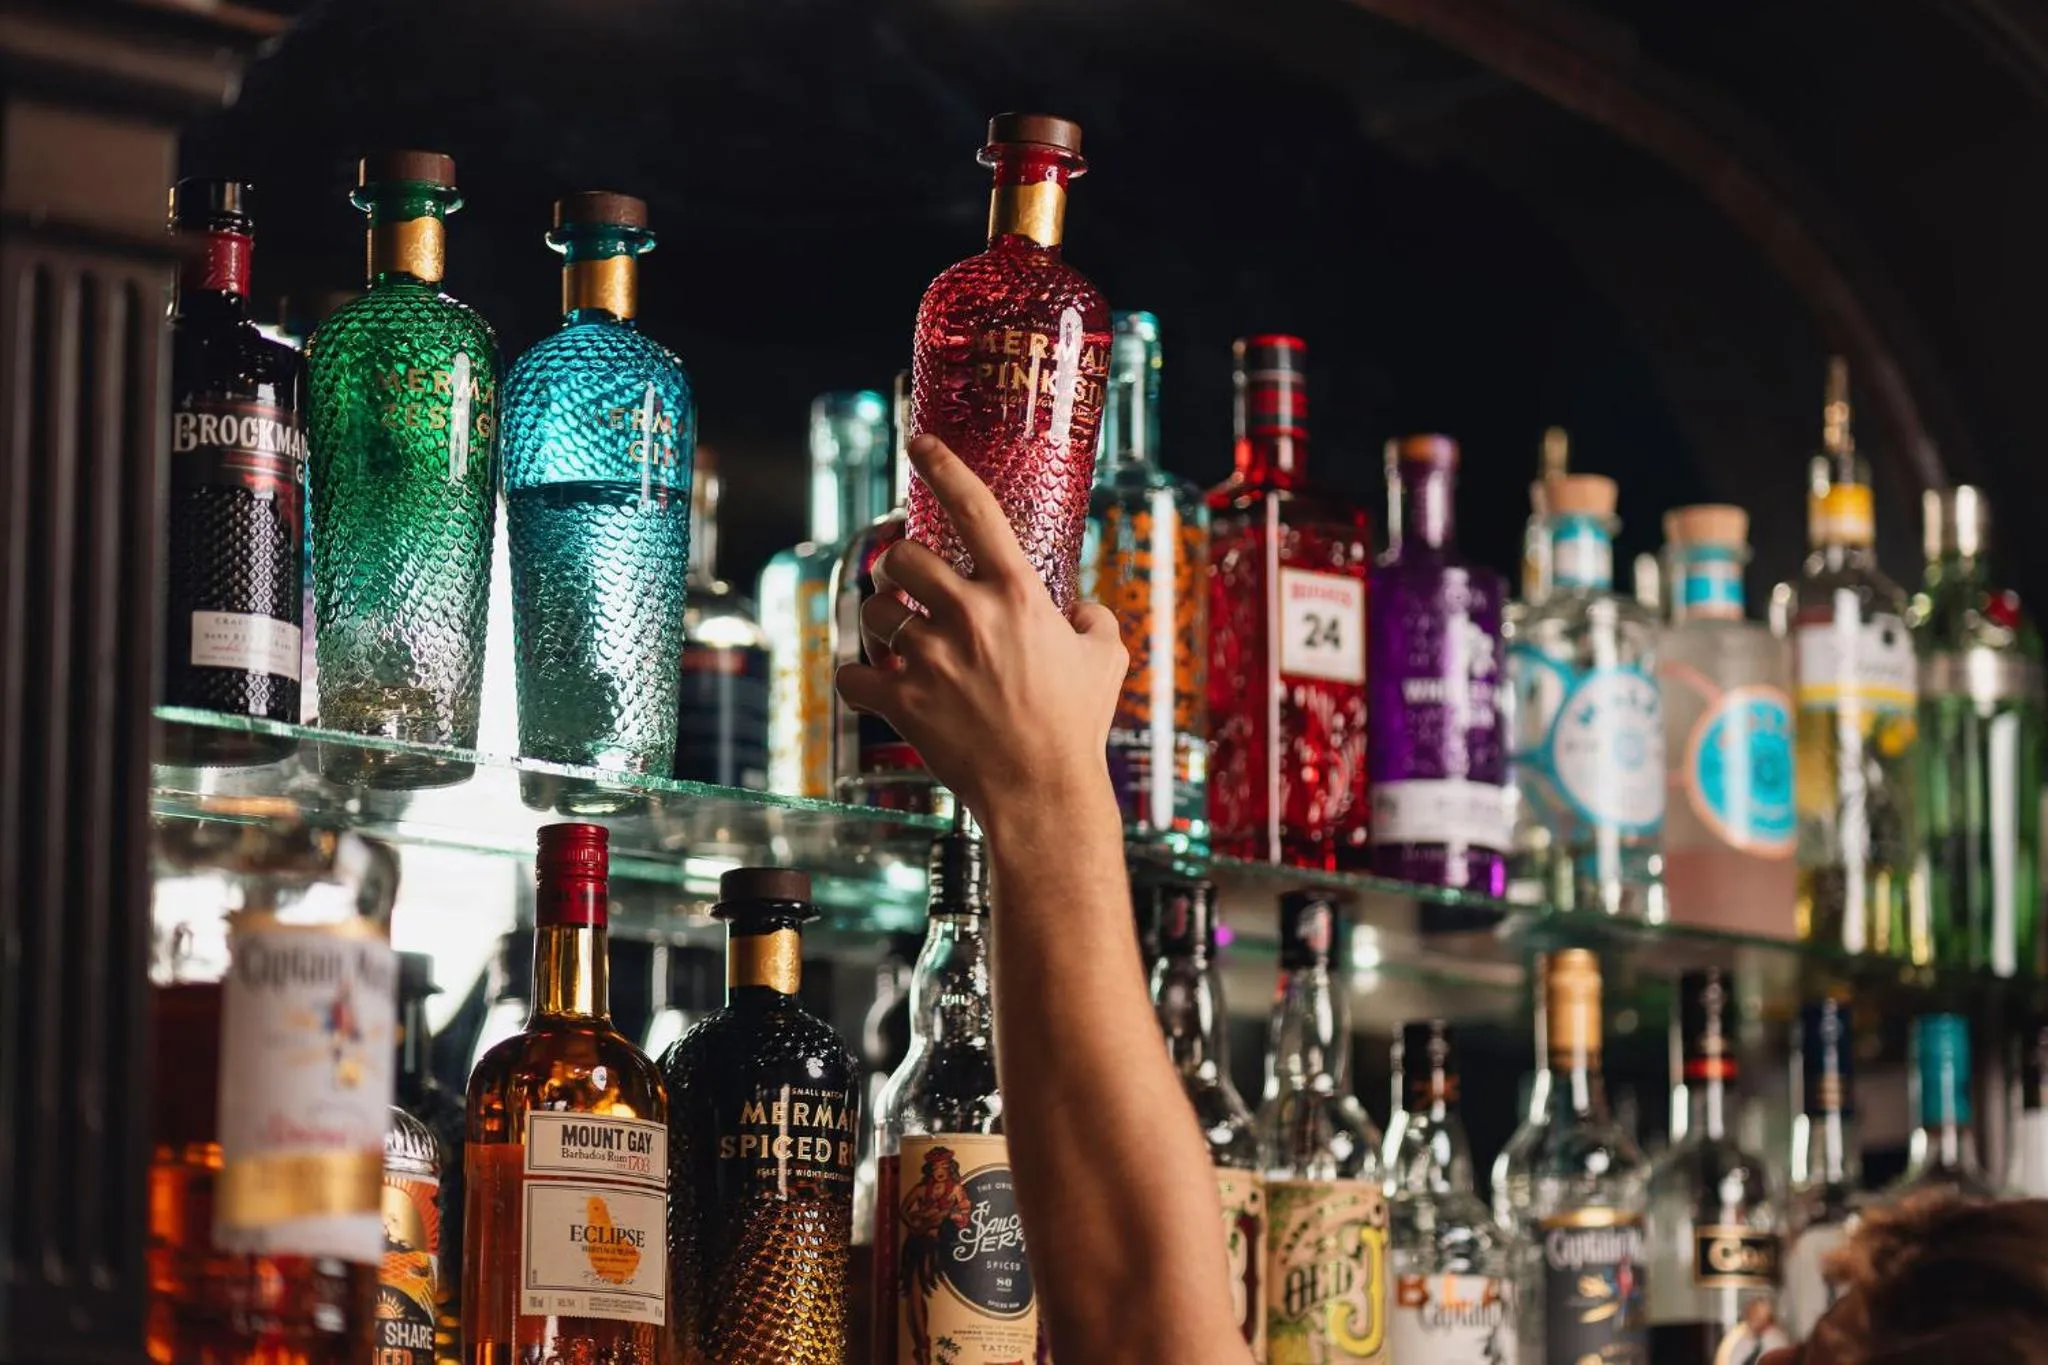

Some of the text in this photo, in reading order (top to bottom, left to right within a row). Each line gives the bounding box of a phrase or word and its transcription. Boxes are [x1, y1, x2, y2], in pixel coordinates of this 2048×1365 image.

[1303, 613, 1342, 650] 24
[791, 1087, 819, 1098] SMALL
[561, 1124, 652, 1155] MOUNT GAY
[561, 1148, 627, 1163] Barbados Rum
[719, 1133, 833, 1164] SPICED
[628, 1155, 652, 1173] 1703
[796, 1168, 822, 1178] WIGHT
[976, 1183, 992, 1193] THE
[569, 1224, 646, 1249] ECLIPSE
[986, 1260, 1021, 1272] SPICED
[996, 1277, 1013, 1288] 80
[384, 1320, 434, 1351] SHARE
